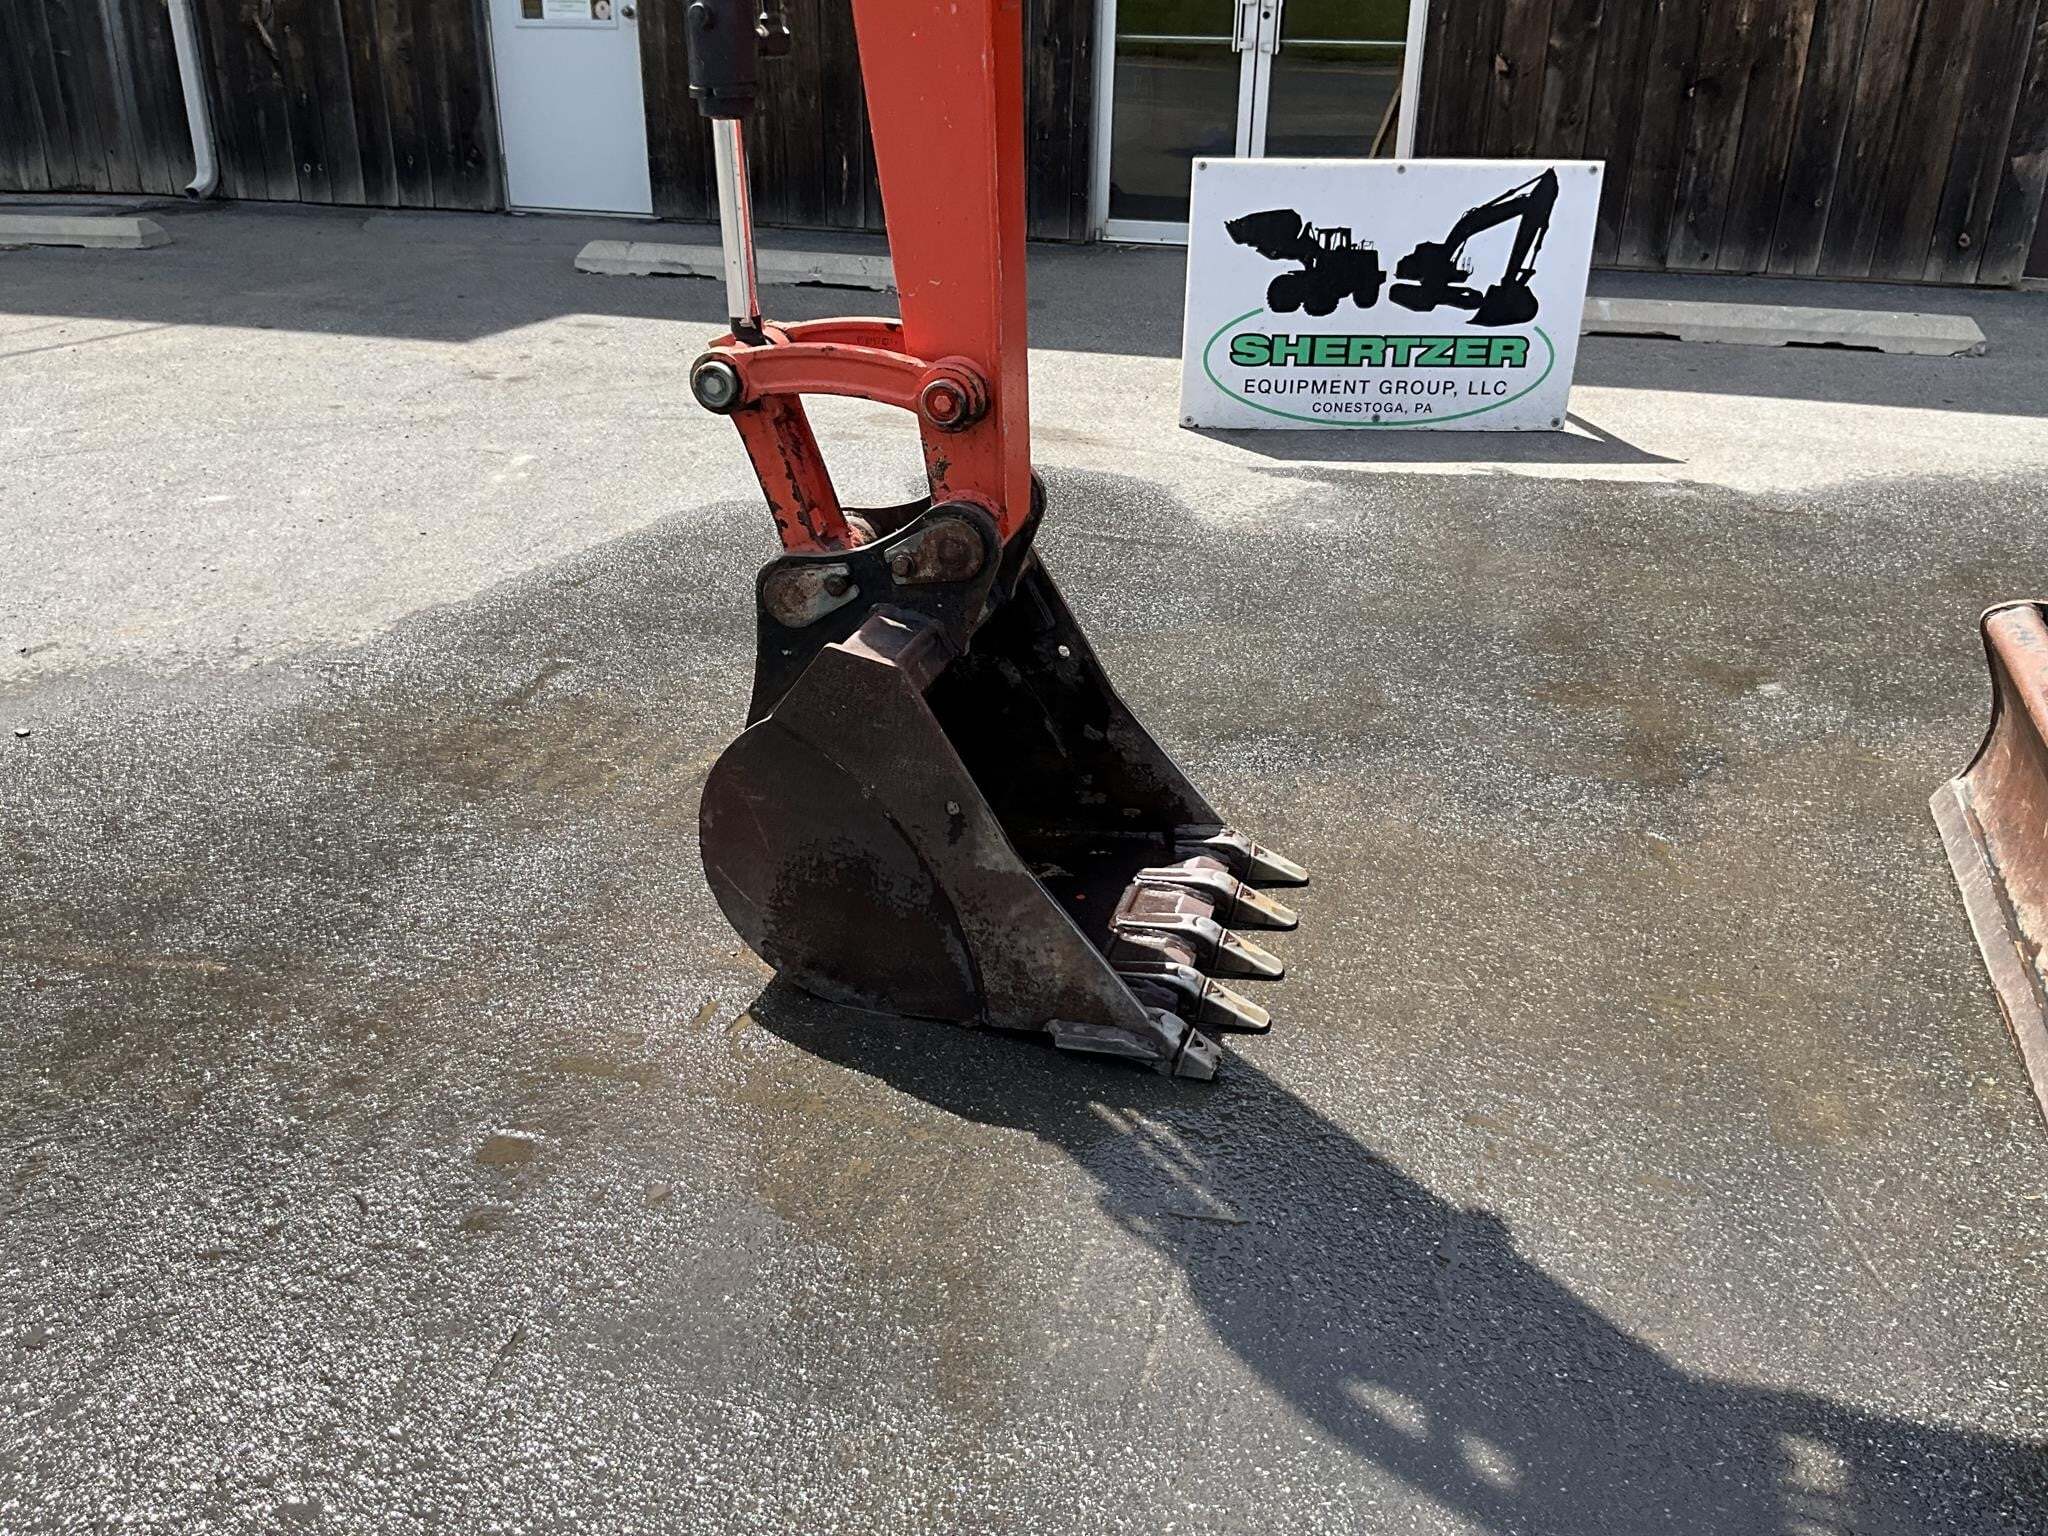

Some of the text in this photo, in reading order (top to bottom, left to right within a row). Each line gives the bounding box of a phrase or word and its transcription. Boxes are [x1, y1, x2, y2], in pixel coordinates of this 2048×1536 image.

[1230, 333, 1530, 368] SHERTZER
[1243, 379, 1508, 398] EQUIPMENT GROUP, LLC
[1312, 402, 1433, 415] CONESTOGA, PA
